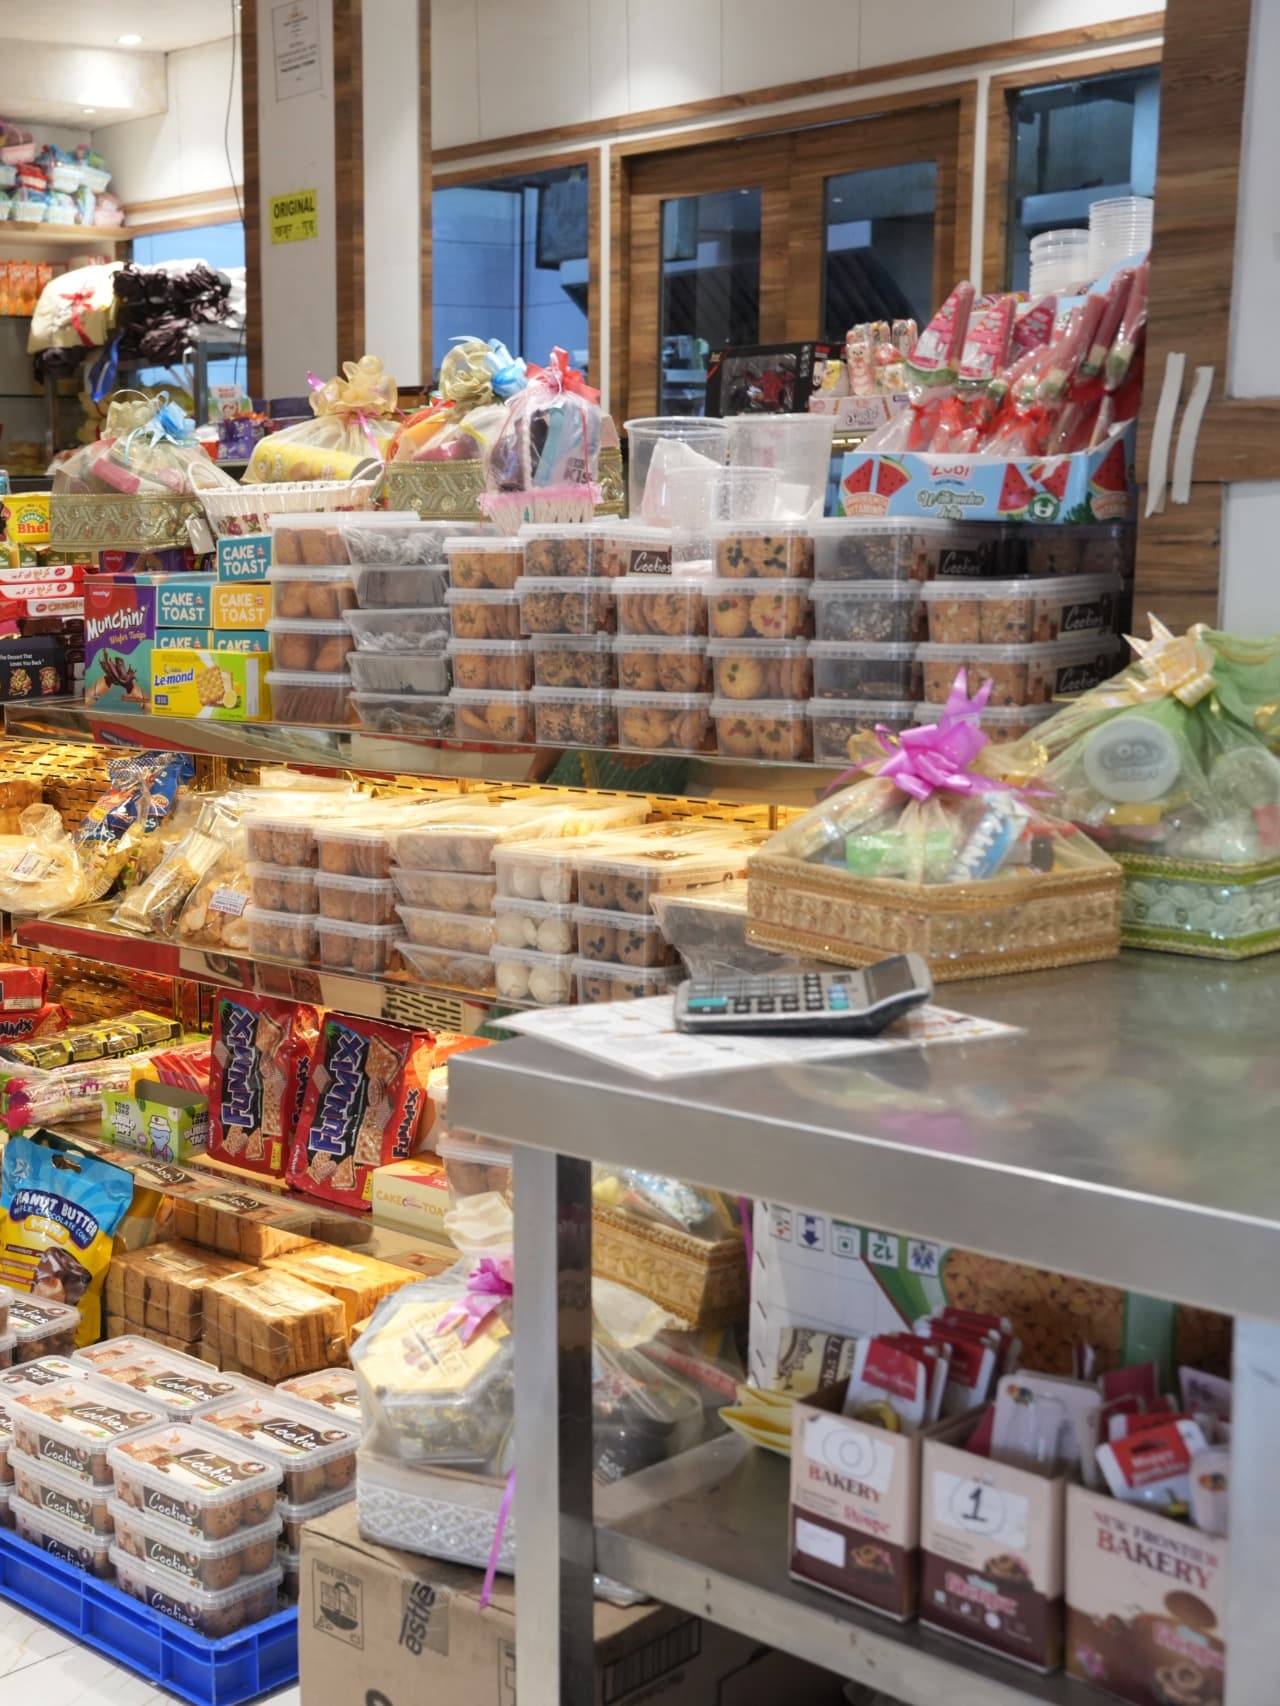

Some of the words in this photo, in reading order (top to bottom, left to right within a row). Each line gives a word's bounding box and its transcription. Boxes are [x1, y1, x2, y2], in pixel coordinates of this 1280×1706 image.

[273, 196, 315, 219] ORIGINAL
[17, 522, 49, 534] Bhel
[222, 545, 255, 559] CAKE
[634, 553, 672, 573] Cookies
[942, 552, 981, 574] Cookies
[223, 559, 266, 576] TOAST
[161, 593, 194, 606] CAKE
[220, 594, 253, 607] CAKE
[161, 607, 205, 622] TOAST
[220, 608, 265, 622] TOAST
[1065, 606, 1103, 630] Cookies
[160, 637, 192, 649] CAKE
[217, 640, 251, 651] CAKE
[376, 1190, 402, 1206] CAKE
[61, 1203, 98, 1238] BUTTER
[872, 1243, 893, 1261] 12
[155, 1377, 213, 1401] Cookies
[74, 1402, 131, 1432] Cookies
[44, 1441, 84, 1471] Cookies
[180, 1453, 241, 1485] Cookies
[808, 1464, 880, 1503] BAKERY
[46, 1491, 86, 1522] Cookies
[148, 1492, 193, 1526] Cookies
[960, 1487, 988, 1523] 1
[1093, 1510, 1127, 1532] NEW
[1133, 1527, 1218, 1568] FRONTIER
[150, 1543, 194, 1577] Cookies
[1097, 1528, 1211, 1590] BAKERY
[151, 1592, 195, 1627] Cookies
